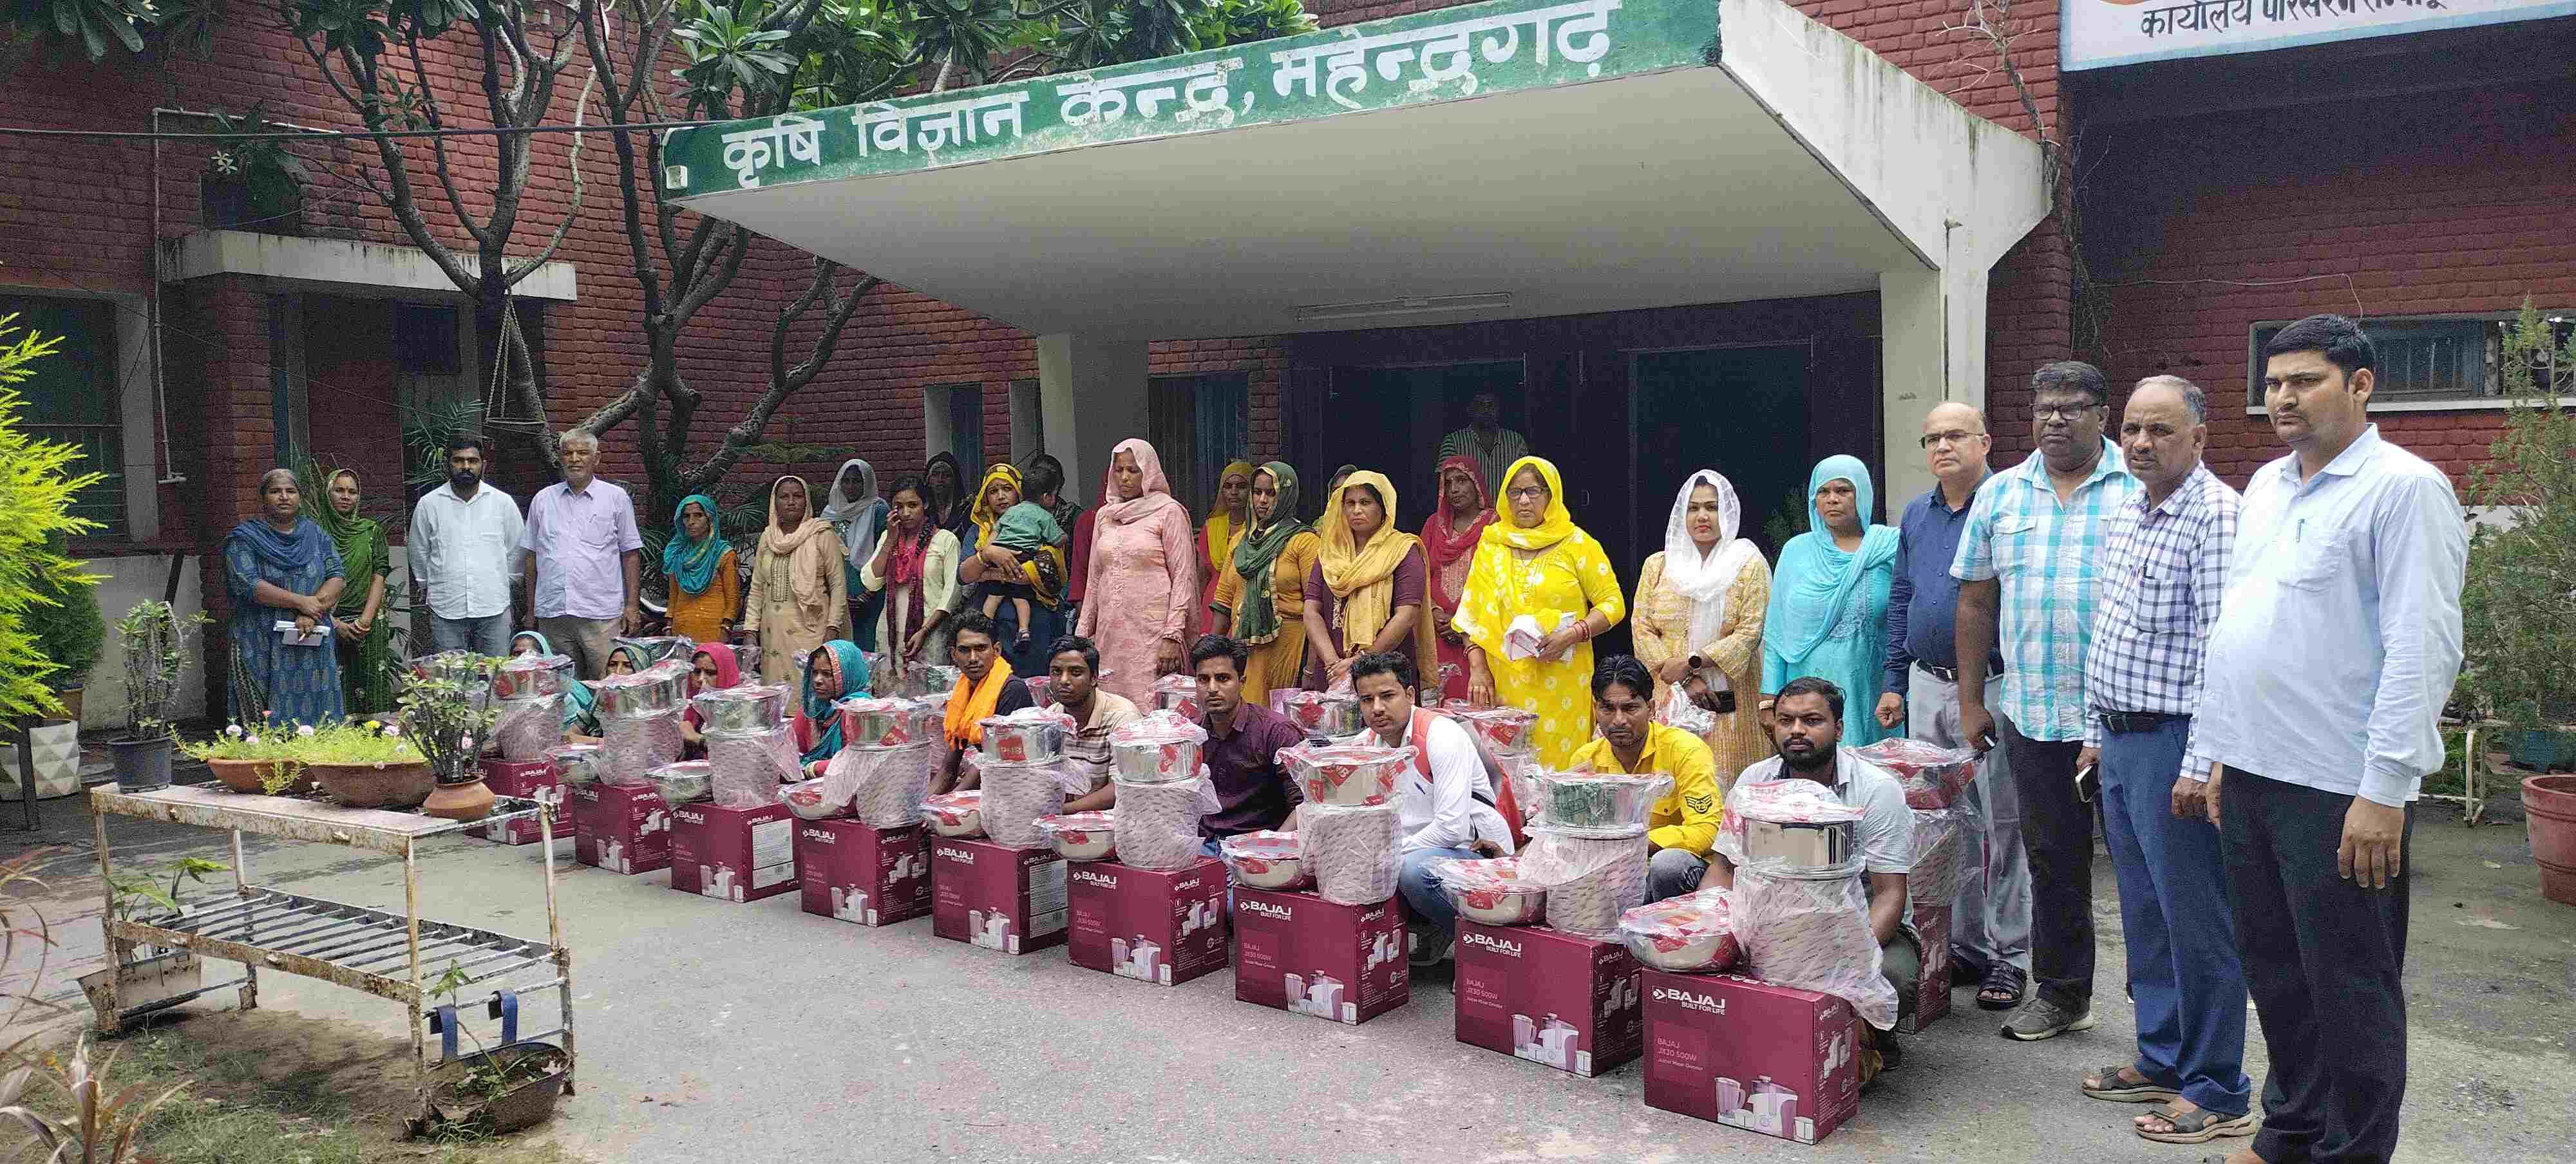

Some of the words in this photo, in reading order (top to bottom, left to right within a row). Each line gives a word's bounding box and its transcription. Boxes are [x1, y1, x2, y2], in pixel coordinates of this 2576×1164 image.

[722, 113, 825, 188] कृषि
[851, 91, 1029, 158] विज्ञान
[679, 811, 703, 820] BAJAJ
[809, 829, 835, 840] BAJAJ
[944, 848, 974, 859] BAJAJ
[1082, 871, 1117, 885] BAJAJ
[1180, 878, 1199, 888] BAJAJ
[1250, 901, 1292, 915] BAJAJ
[1366, 907, 1385, 919] BAJAJ
[1474, 934, 1522, 952] BAJAJ
[1667, 988, 1726, 1009] BAJAJ
[1681, 1001, 1698, 1010] BUILT
[1700, 1004, 1711, 1013] FOR
[1712, 1007, 1726, 1015] LIFE
[1657, 1038, 1680, 1048] BAJAJ
